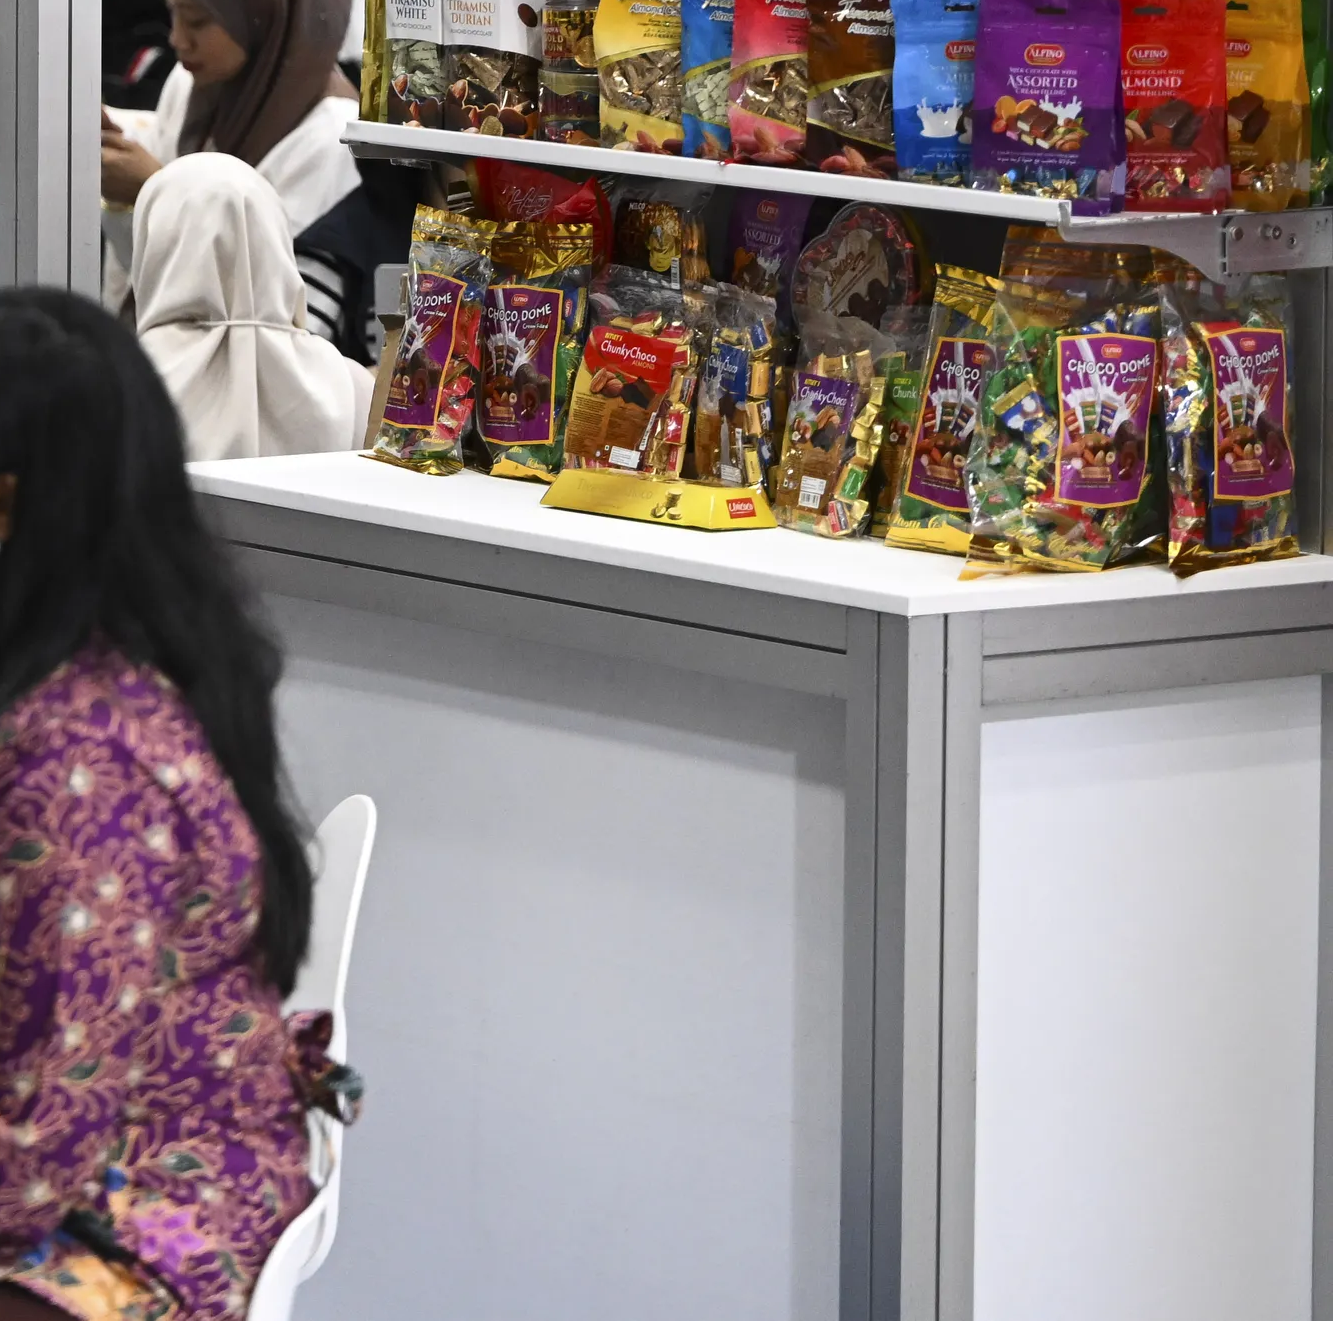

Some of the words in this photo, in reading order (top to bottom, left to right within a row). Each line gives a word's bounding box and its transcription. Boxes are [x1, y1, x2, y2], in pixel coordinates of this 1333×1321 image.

[396, 6, 427, 20] WHITE
[629, 3, 663, 16] Almond
[450, 12, 491, 26] DURIAN
[848, 23, 887, 36] Almond
[1028, 46, 1063, 58] ALFINO
[1131, 48, 1167, 58] ALFINO
[1006, 74, 1078, 90] ASSORTED
[424, 292, 453, 307] DOME
[488, 307, 518, 322] CHOCO
[522, 303, 552, 320] DOME
[1219, 354, 1253, 368] CHOCO
[1255, 344, 1280, 365] DOME
[632, 360, 655, 371] ALMOND
[941, 359, 980, 380] CHOCO
[1068, 358, 1115, 375] CHOCO
[1119, 353, 1151, 373] DOME
